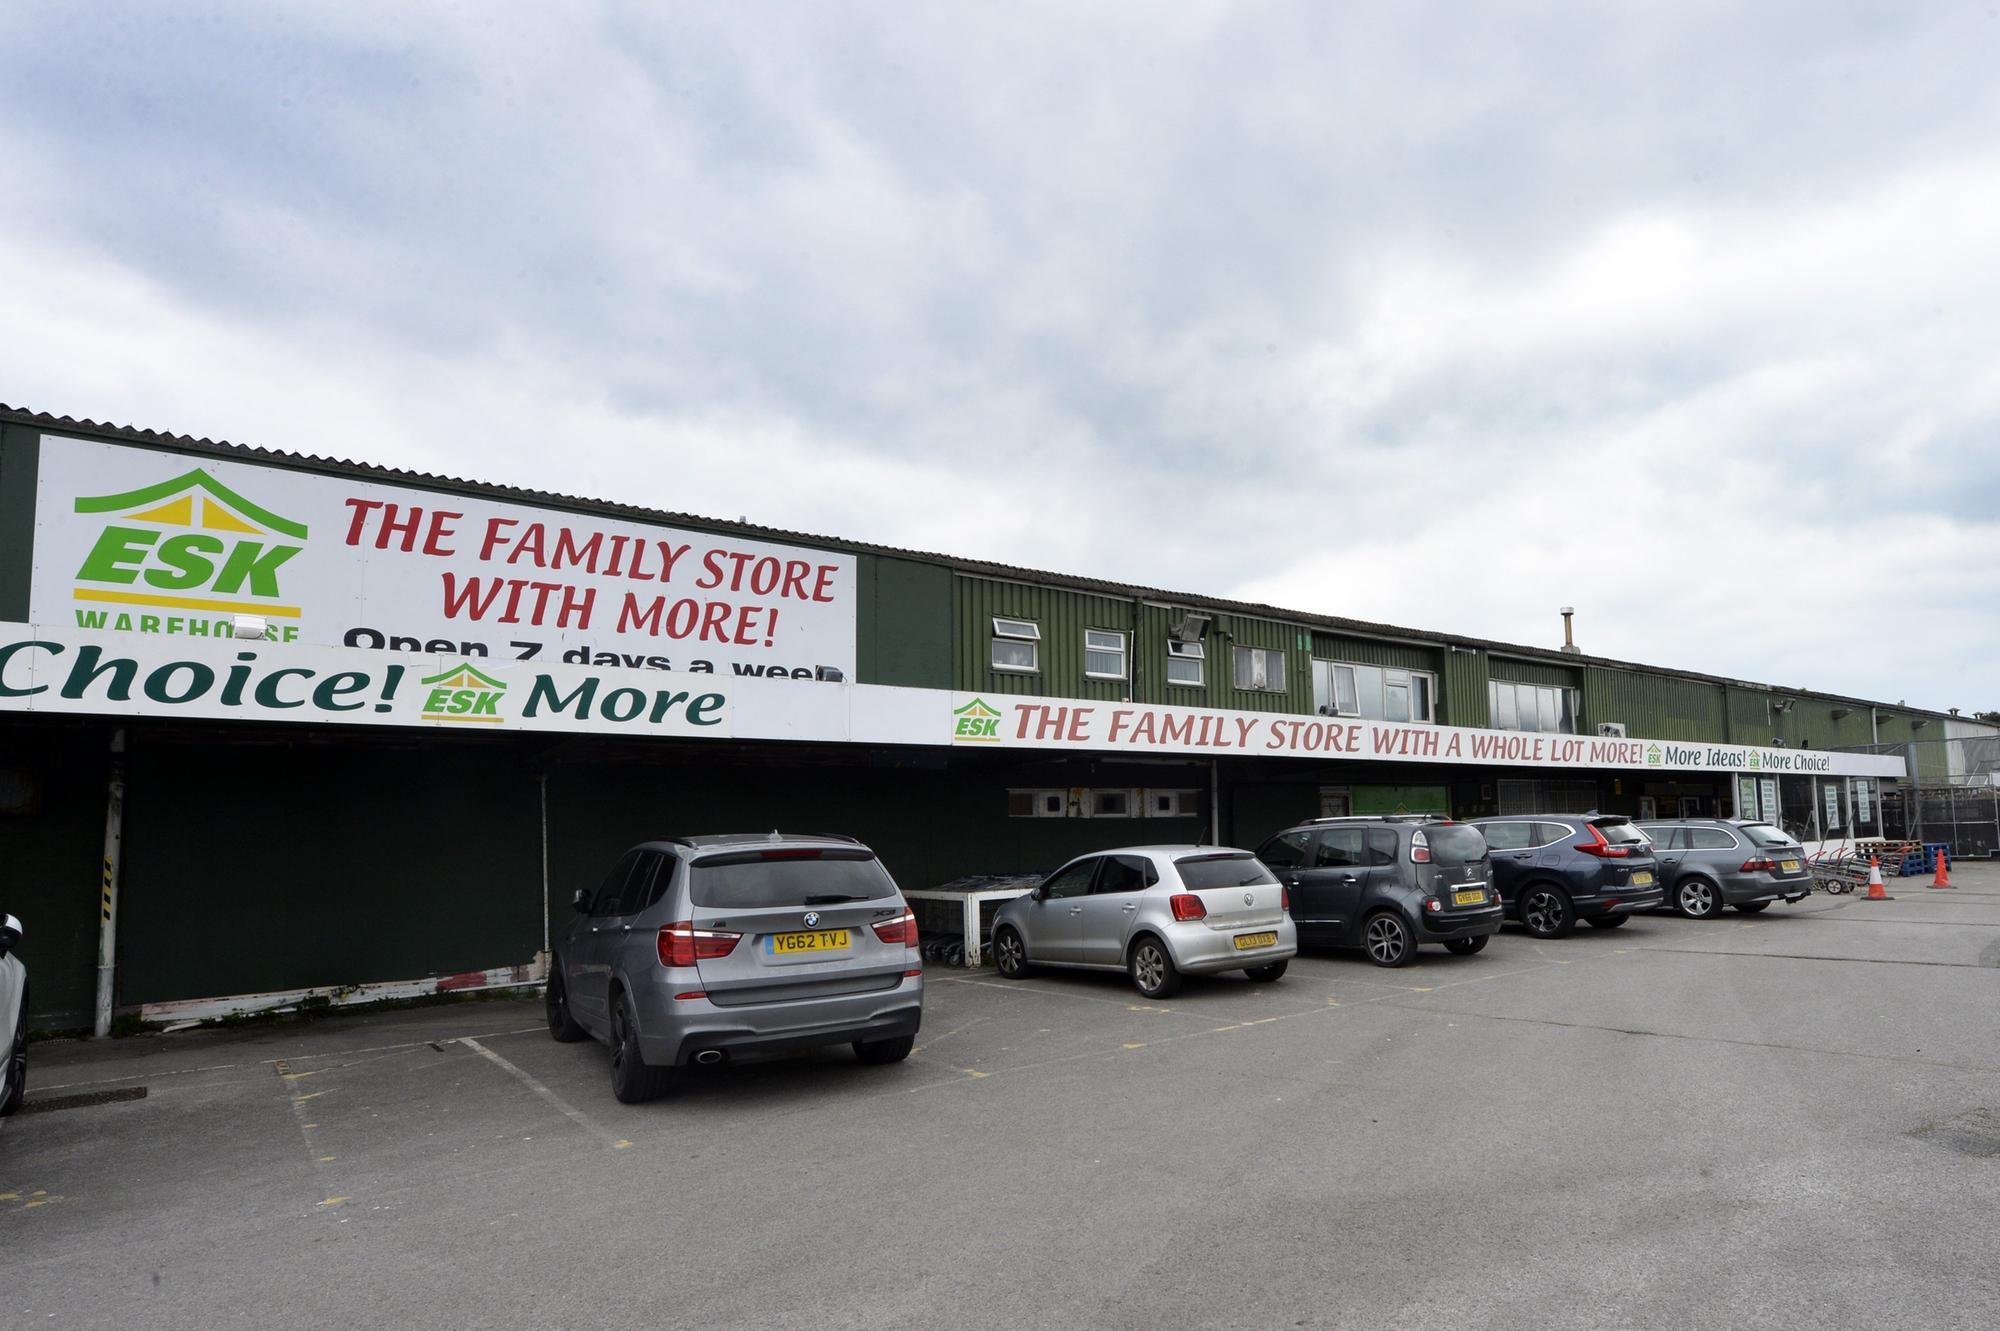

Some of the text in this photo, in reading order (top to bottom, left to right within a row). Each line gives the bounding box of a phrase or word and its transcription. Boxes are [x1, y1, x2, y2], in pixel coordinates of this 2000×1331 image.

[75, 525, 304, 597] ESK
[345, 498, 839, 602] THE FAMILY STORE
[75, 609, 299, 642] WAREHOSE
[442, 572, 779, 647] WITH MORE!
[0, 641, 405, 713] Choice!
[510, 641, 543, 660] 7
[689, 659, 713, 674] a
[732, 662, 821, 682] wee
[422, 689, 504, 715] ESK
[522, 674, 726, 725] More
[955, 718, 1000, 737] ESK
[1014, 704, 1643, 764] THE FAMILY STORE WITH A WHOLE LOT MORE!
[1665, 746, 1746, 768] More Ideas!
[1762, 752, 1830, 772] More Choice!
[776, 931, 847, 951] YG62 TVJ
